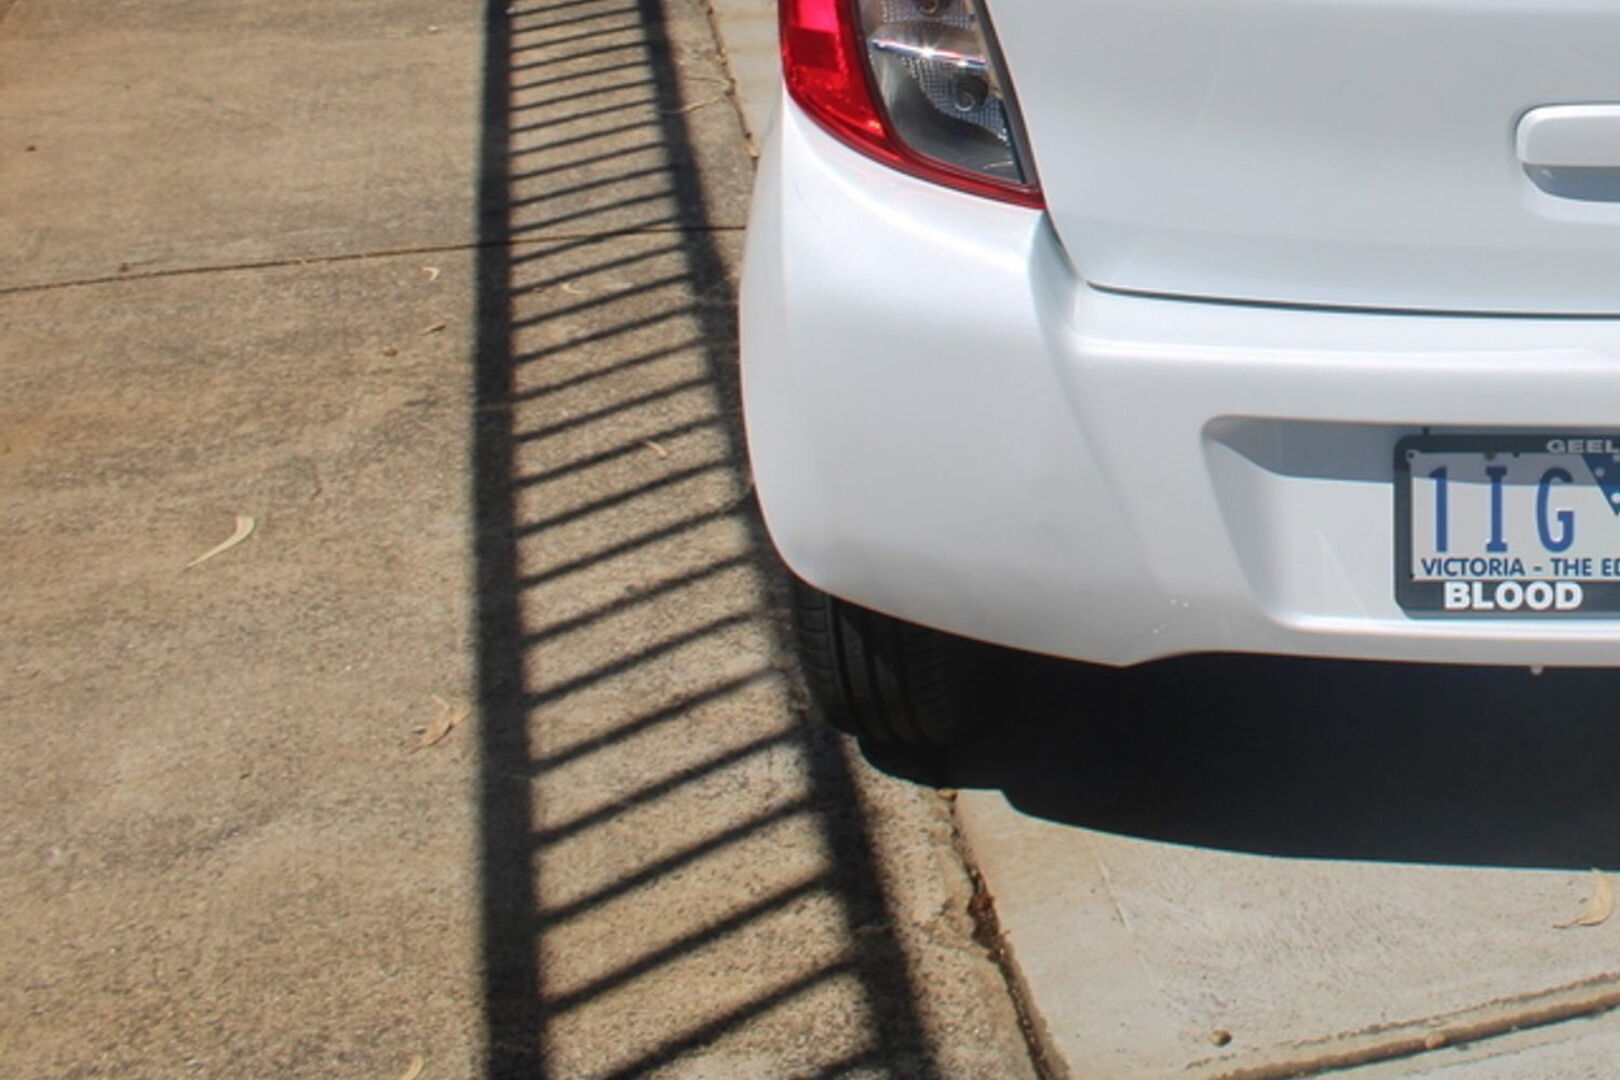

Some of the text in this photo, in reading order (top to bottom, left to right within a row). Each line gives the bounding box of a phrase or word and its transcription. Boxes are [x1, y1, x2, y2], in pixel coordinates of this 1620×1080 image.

[1420, 557, 1526, 578] VICTORIA
[1550, 557, 1593, 577] THE
[1443, 581, 1583, 610] BLOOD
